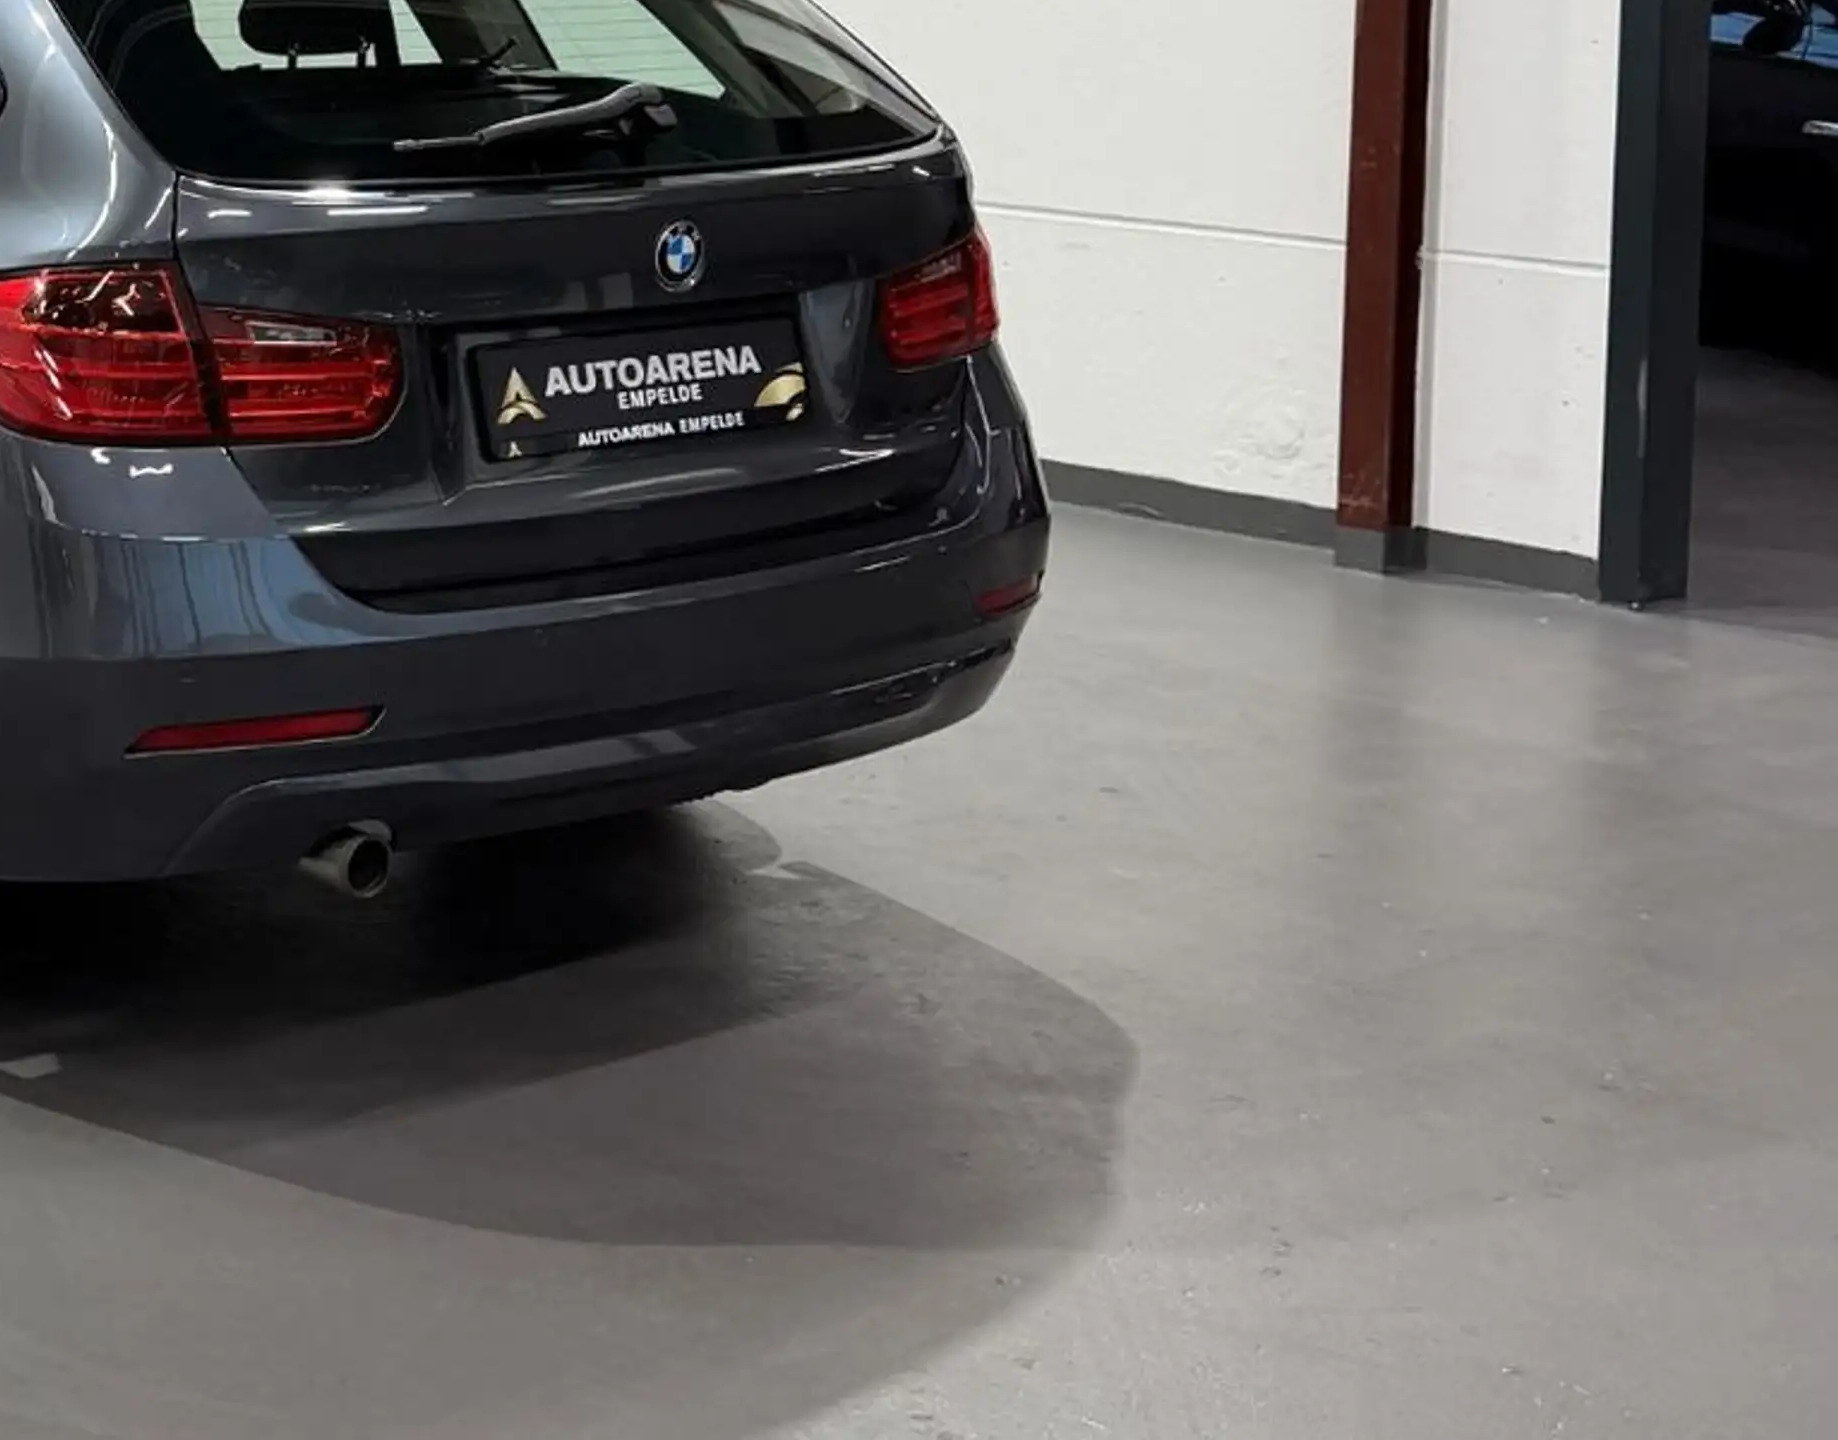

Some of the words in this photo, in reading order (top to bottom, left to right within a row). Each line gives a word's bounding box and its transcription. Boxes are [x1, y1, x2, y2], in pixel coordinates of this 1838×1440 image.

[544, 345, 762, 397] AUTOARENA
[617, 383, 703, 409] EMPELDE
[578, 420, 676, 447] AUTOARENA
[678, 411, 744, 434] EMPELDE
